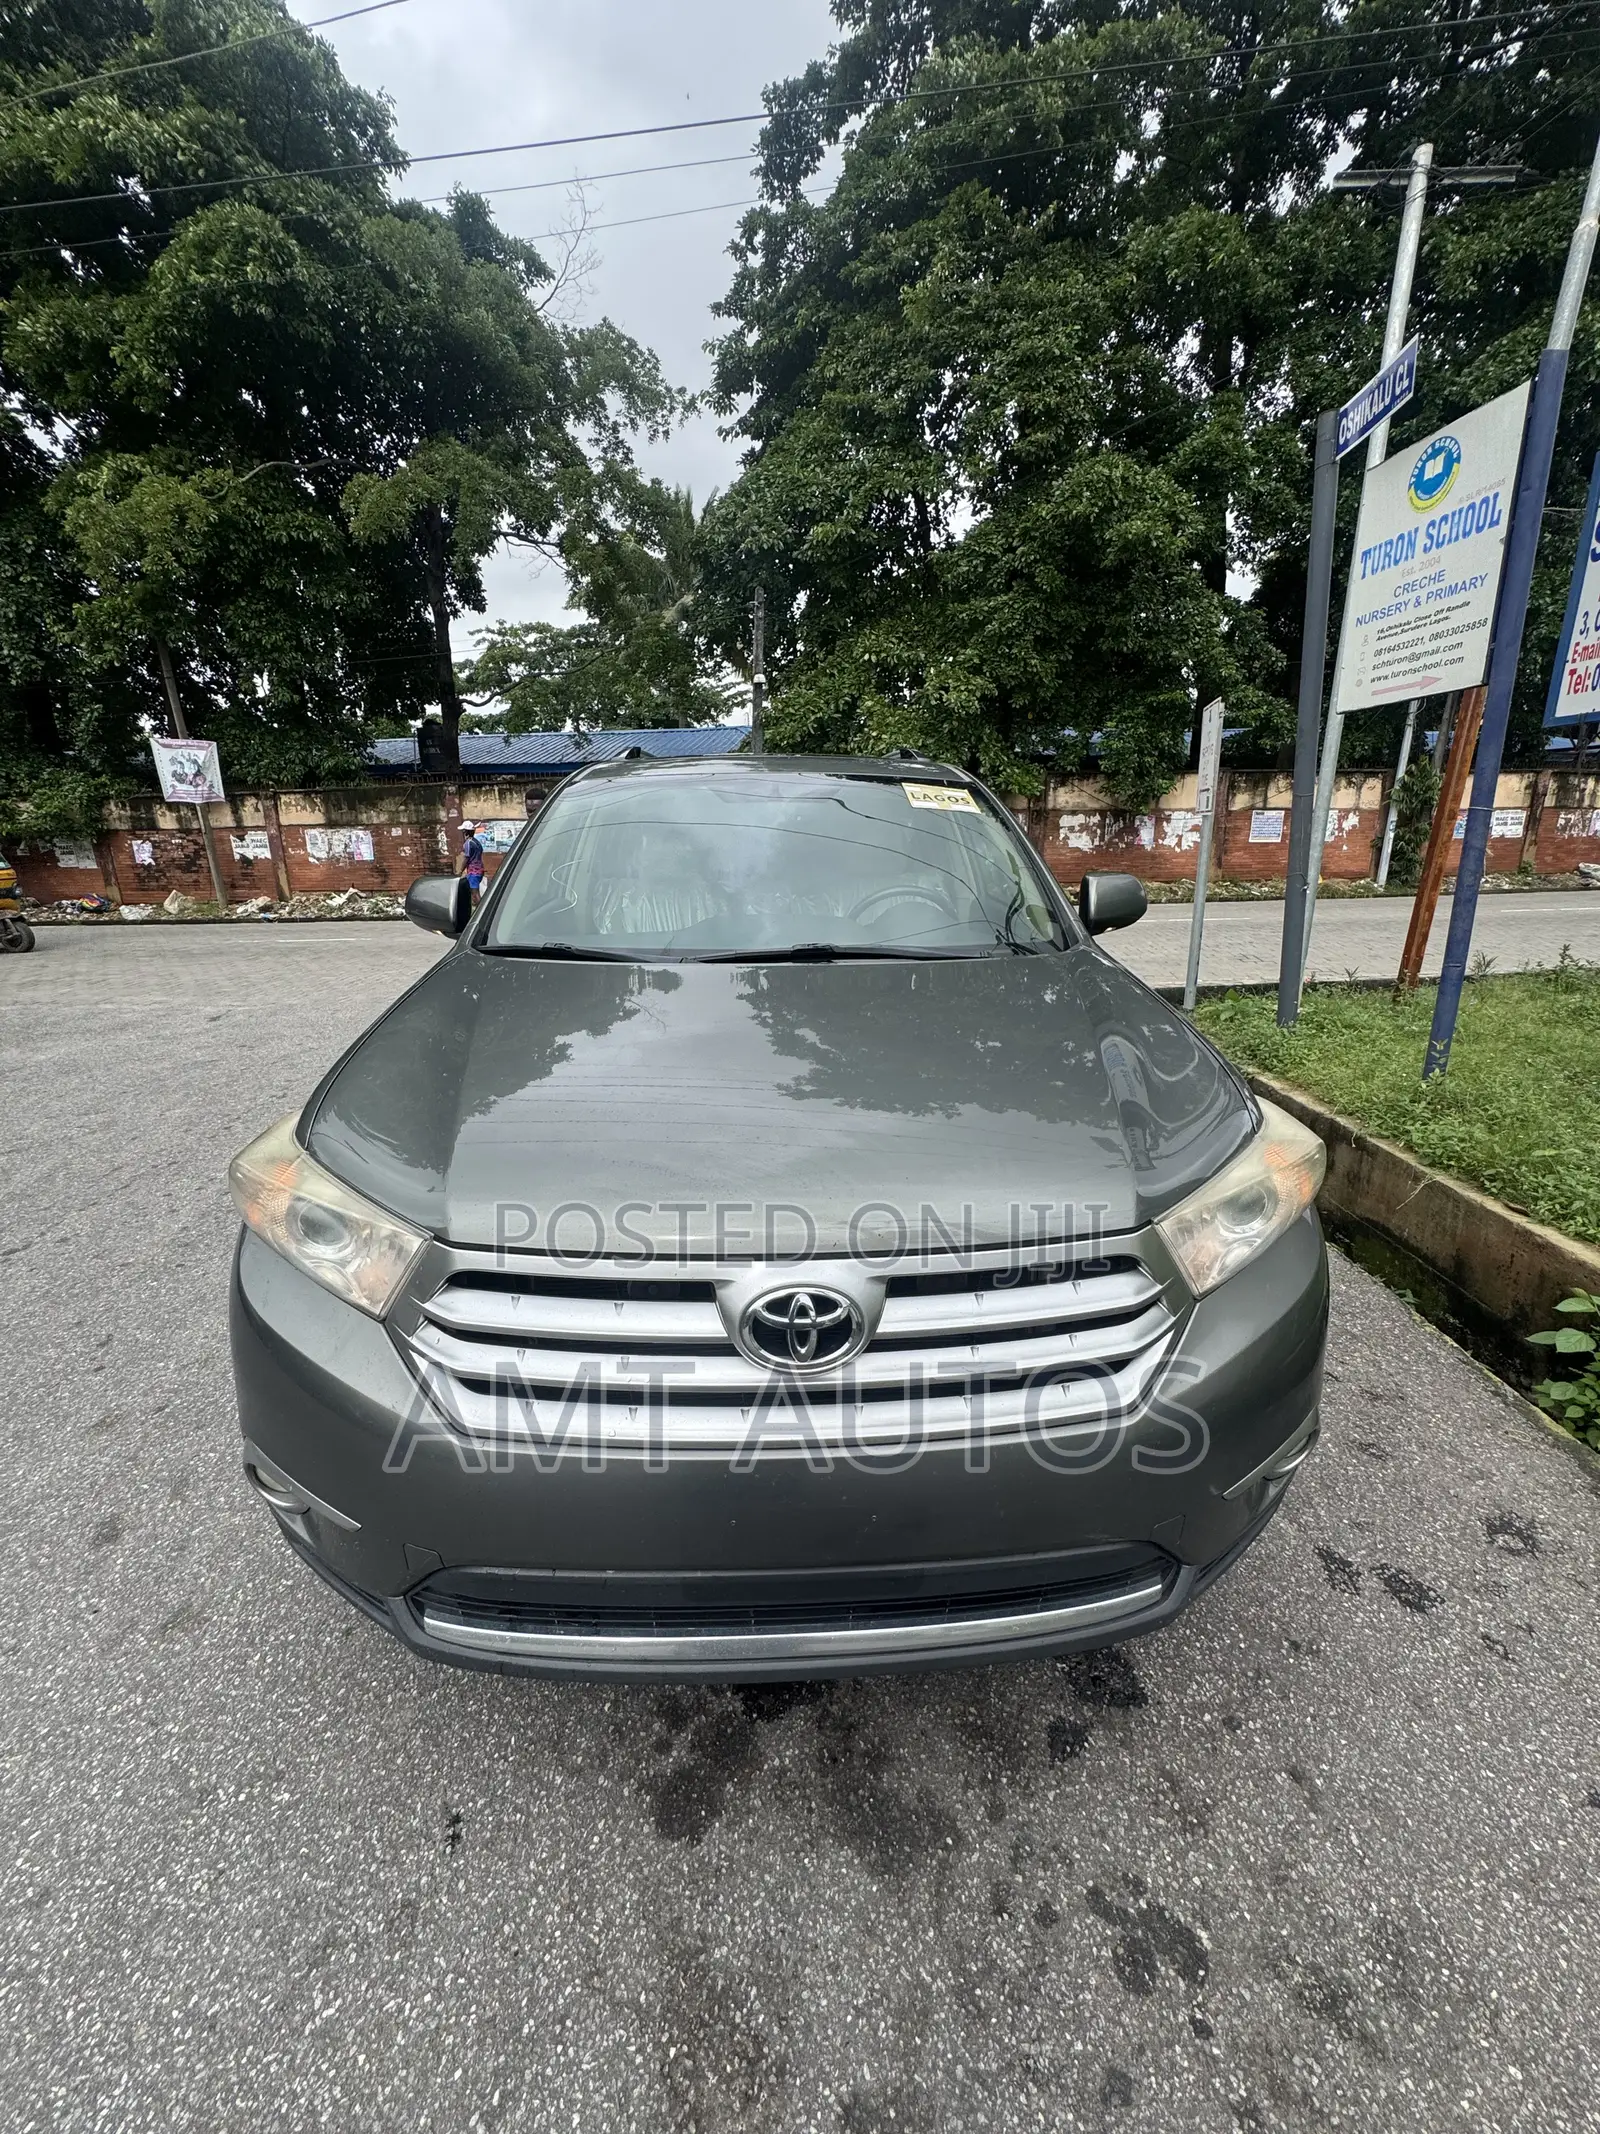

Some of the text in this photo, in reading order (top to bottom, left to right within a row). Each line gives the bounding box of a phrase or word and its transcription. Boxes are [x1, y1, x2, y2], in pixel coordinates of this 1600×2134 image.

[1339, 360, 1410, 445] OSHIKALU CL
[1360, 491, 1502, 580] TURON SCHOOL
[1402, 555, 1441, 578] Est. 2004
[1393, 569, 1446, 598] CRECHE
[1355, 573, 1489, 628] NURSERY & PRIMARY
[1413, 613, 1432, 623] Close
[1433, 609, 1445, 617] Off
[1428, 617, 1489, 642] 08033025858
[1370, 656, 1464, 683] www.turonschool.com
[1371, 641, 1464, 671] schturon@gmail.com
[909, 792, 971, 805] LAGOS
